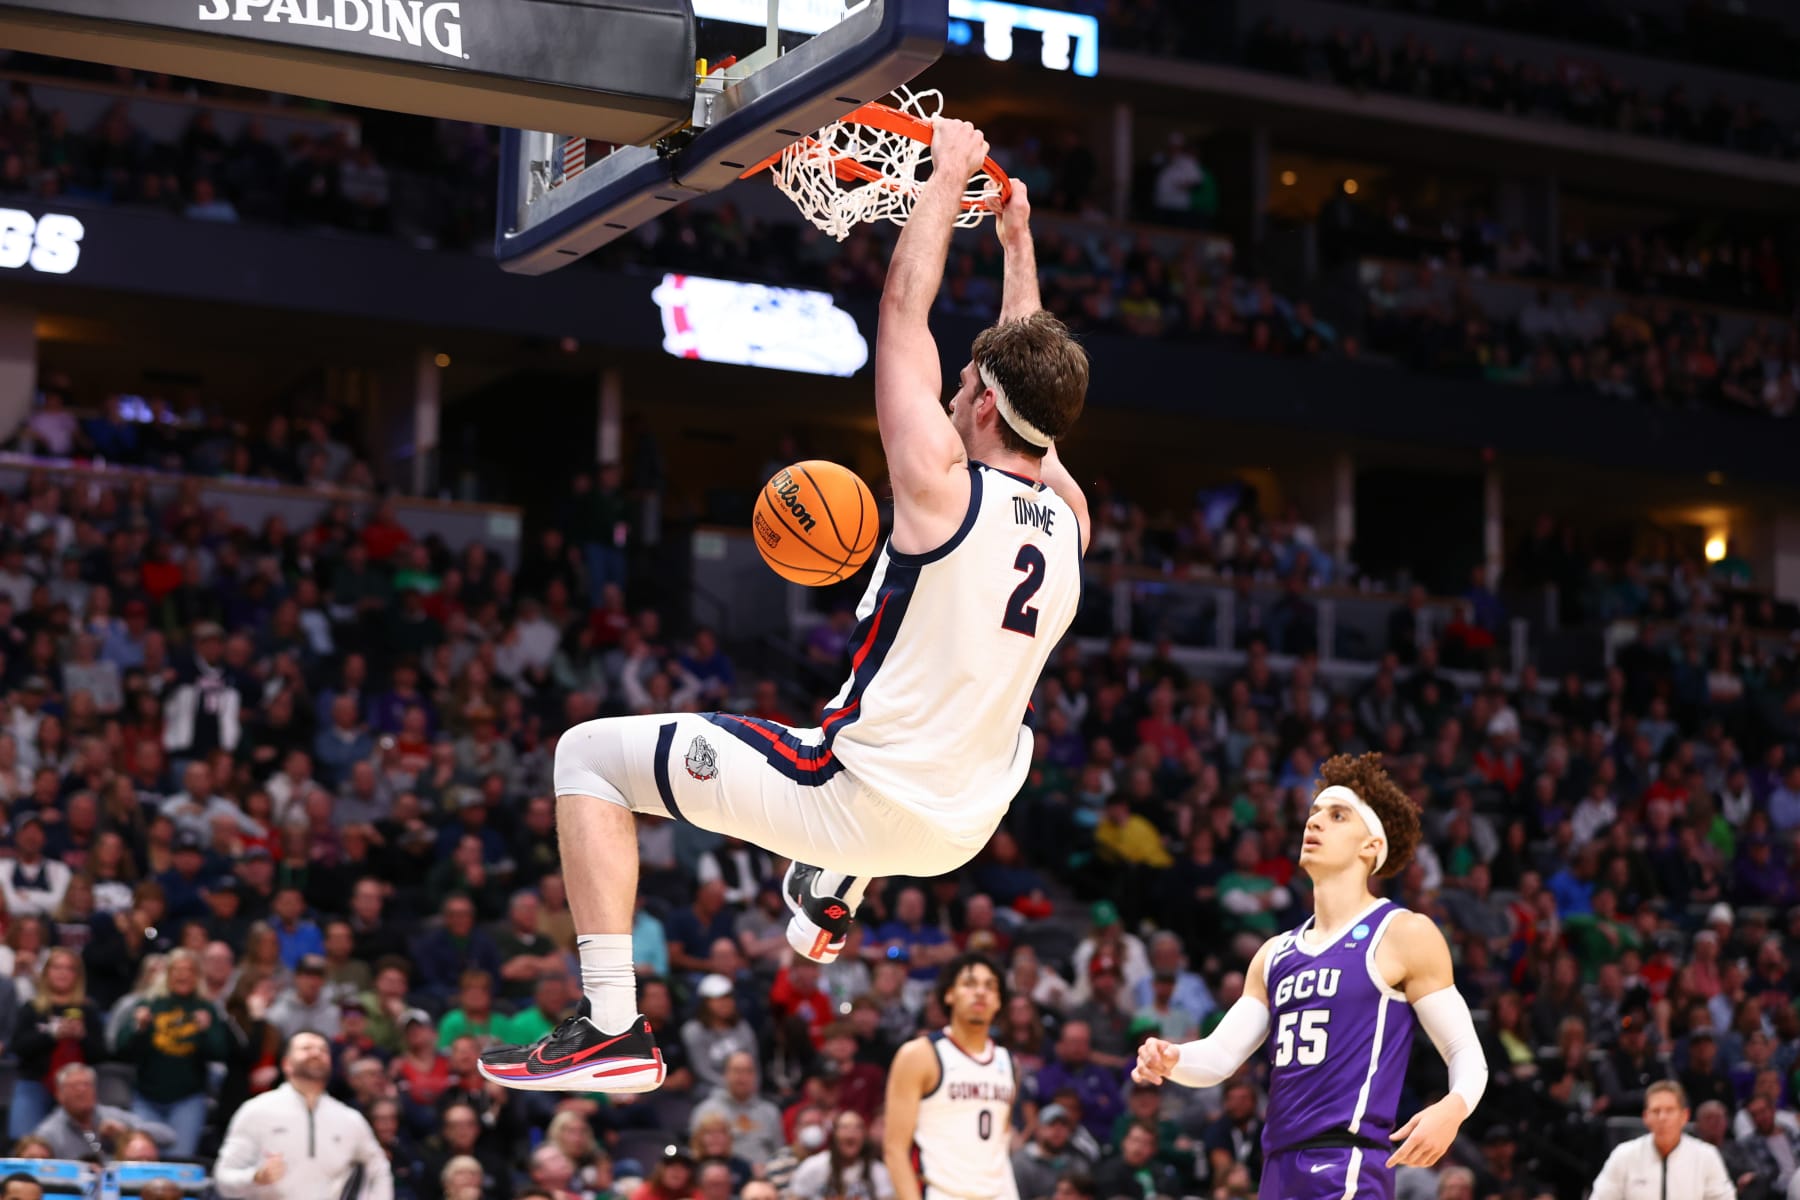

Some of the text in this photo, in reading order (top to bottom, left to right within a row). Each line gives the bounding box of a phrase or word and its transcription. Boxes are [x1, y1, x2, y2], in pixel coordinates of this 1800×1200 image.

[771, 469, 817, 534] Wilson
[1012, 496, 1055, 536] TIMME
[1001, 544, 1046, 638] 2
[1275, 967, 1341, 1008] GCU
[1275, 1008, 1331, 1067] 55
[979, 1109, 992, 1141] 0
